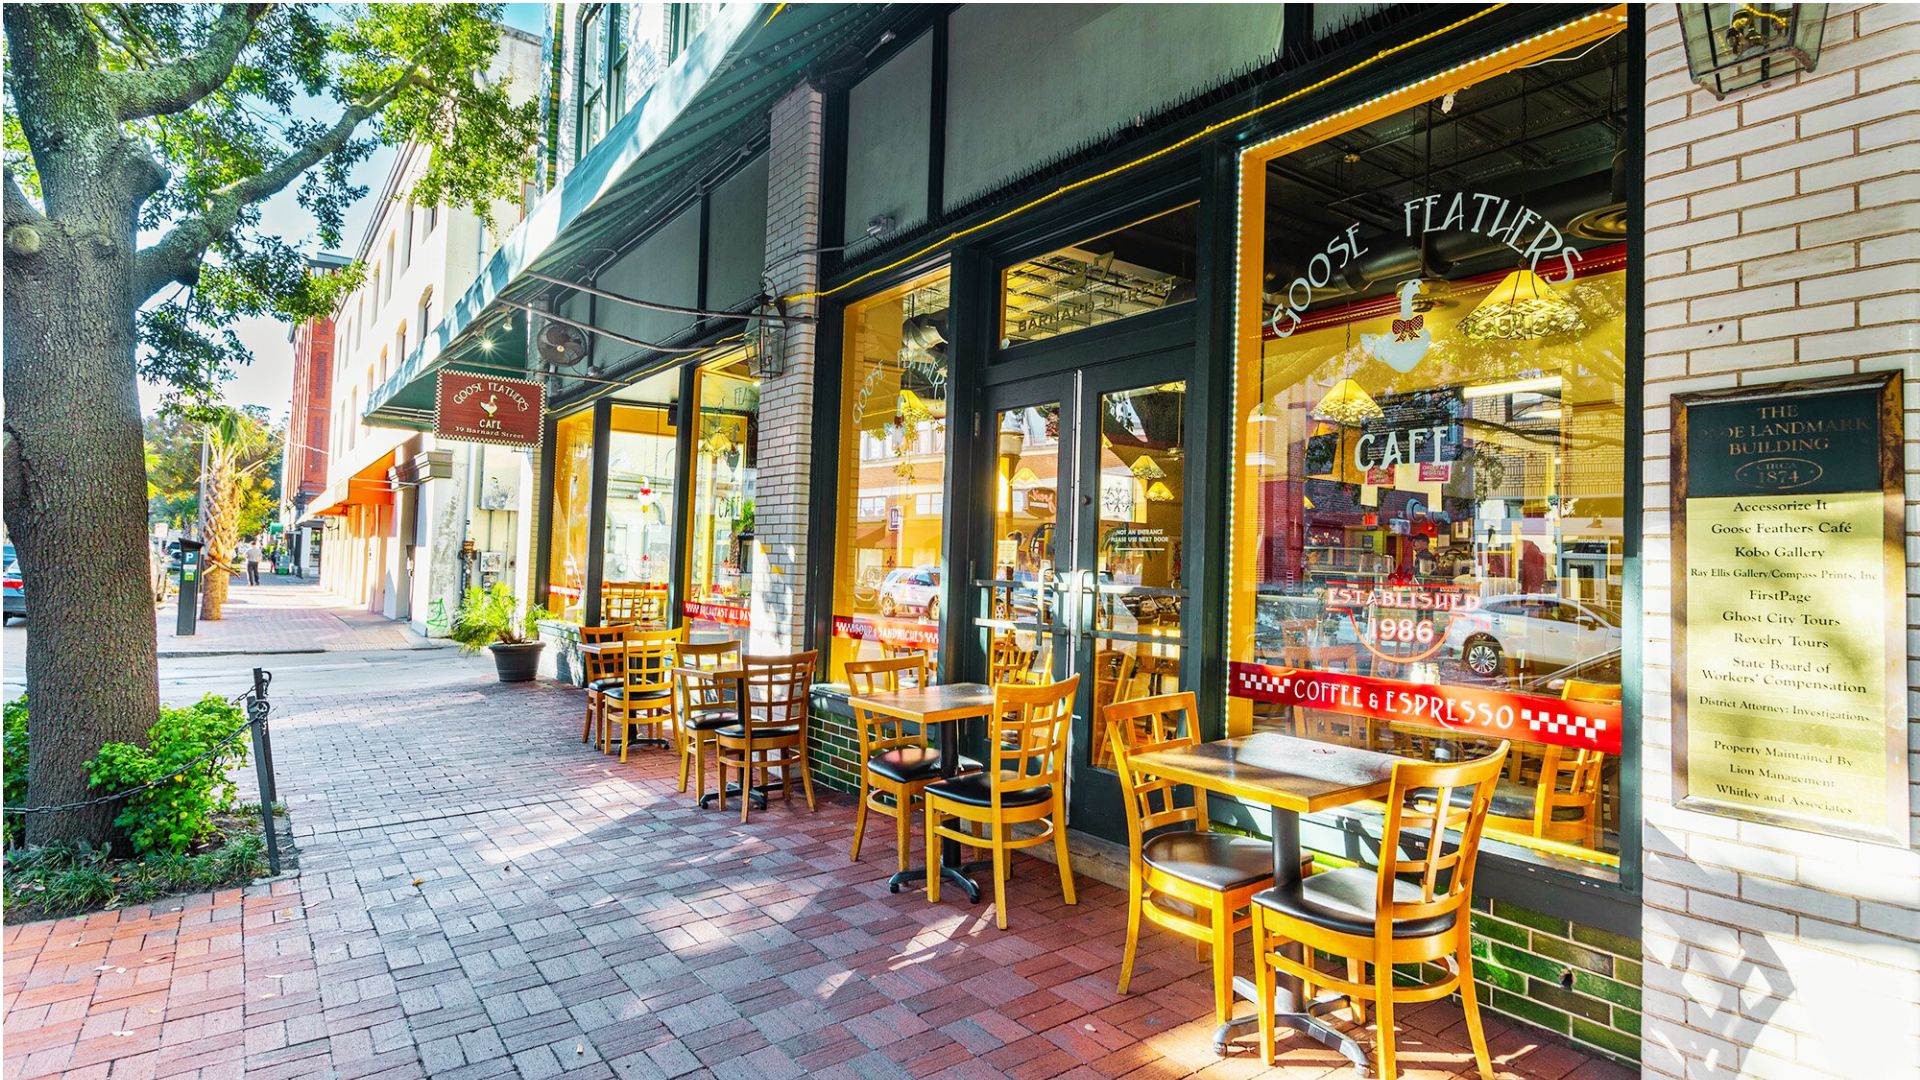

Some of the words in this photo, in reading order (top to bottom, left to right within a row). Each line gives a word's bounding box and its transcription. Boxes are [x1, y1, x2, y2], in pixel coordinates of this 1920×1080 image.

[1271, 222, 1369, 339] GOOSE
[1403, 191, 1584, 285] FEATHERS
[1018, 300, 1095, 333] BARNARD
[453, 383, 484, 405] GOOSE
[488, 382, 530, 412] FEATHERS
[1757, 405, 1799, 420] THE
[466, 427, 499, 437] Barnard
[501, 431, 524, 439] Street
[479, 419, 502, 430] CAFE
[1751, 417, 1871, 438] LANDMARK
[1354, 427, 1452, 472] CAFE
[1729, 437, 1830, 456] BUILDING
[1757, 462, 1798, 471] CIRCA
[1758, 470, 1800, 484] 1874
[1733, 500, 1811, 513] Accessorize
[1816, 499, 1828, 511] It
[1711, 523, 1752, 535] Goose
[1756, 522, 1814, 535] Feathers
[1818, 521, 1853, 534] Café
[185, 552, 194, 562] P
[1734, 546, 1770, 558] Kobo
[1774, 547, 1825, 560] Gallery
[1690, 568, 1709, 579] Ray
[1711, 568, 1731, 578] Ellis
[1327, 588, 1481, 611] ESTABLISHED
[1749, 589, 1812, 604] FirstPage
[700, 604, 728, 619] BREAKFAST
[729, 609, 739, 620] ALL
[740, 610, 751, 622] DAY
[1722, 610, 1762, 623] Ghost
[1766, 612, 1796, 625] City
[1801, 613, 1841, 627] Tours
[878, 627, 924, 643] SANDWICHES
[1370, 617, 1435, 644] 1986
[1733, 632, 1784, 646] Revelry
[1789, 635, 1829, 649] Tours
[1732, 656, 1766, 669] State
[1770, 659, 1812, 673] Board
[1816, 662, 1833, 674] of
[1763, 675, 1867, 694] Compensation
[1294, 678, 1365, 709] COFFEE
[1369, 694, 1379, 710] &
[1386, 689, 1515, 731] ESPRESSO
[1699, 695, 1736, 709] District
[1792, 705, 1871, 722] Investigations
[1713, 740, 1762, 755] Property
[1765, 746, 1833, 765] Maintained
[1837, 755, 1854, 768] By
[1729, 763, 1755, 777] Lion
[1758, 767, 1835, 788] Management
[1715, 783, 1761, 801] Whitley
[1763, 791, 1785, 804] and
[1791, 796, 1853, 816] Associates
